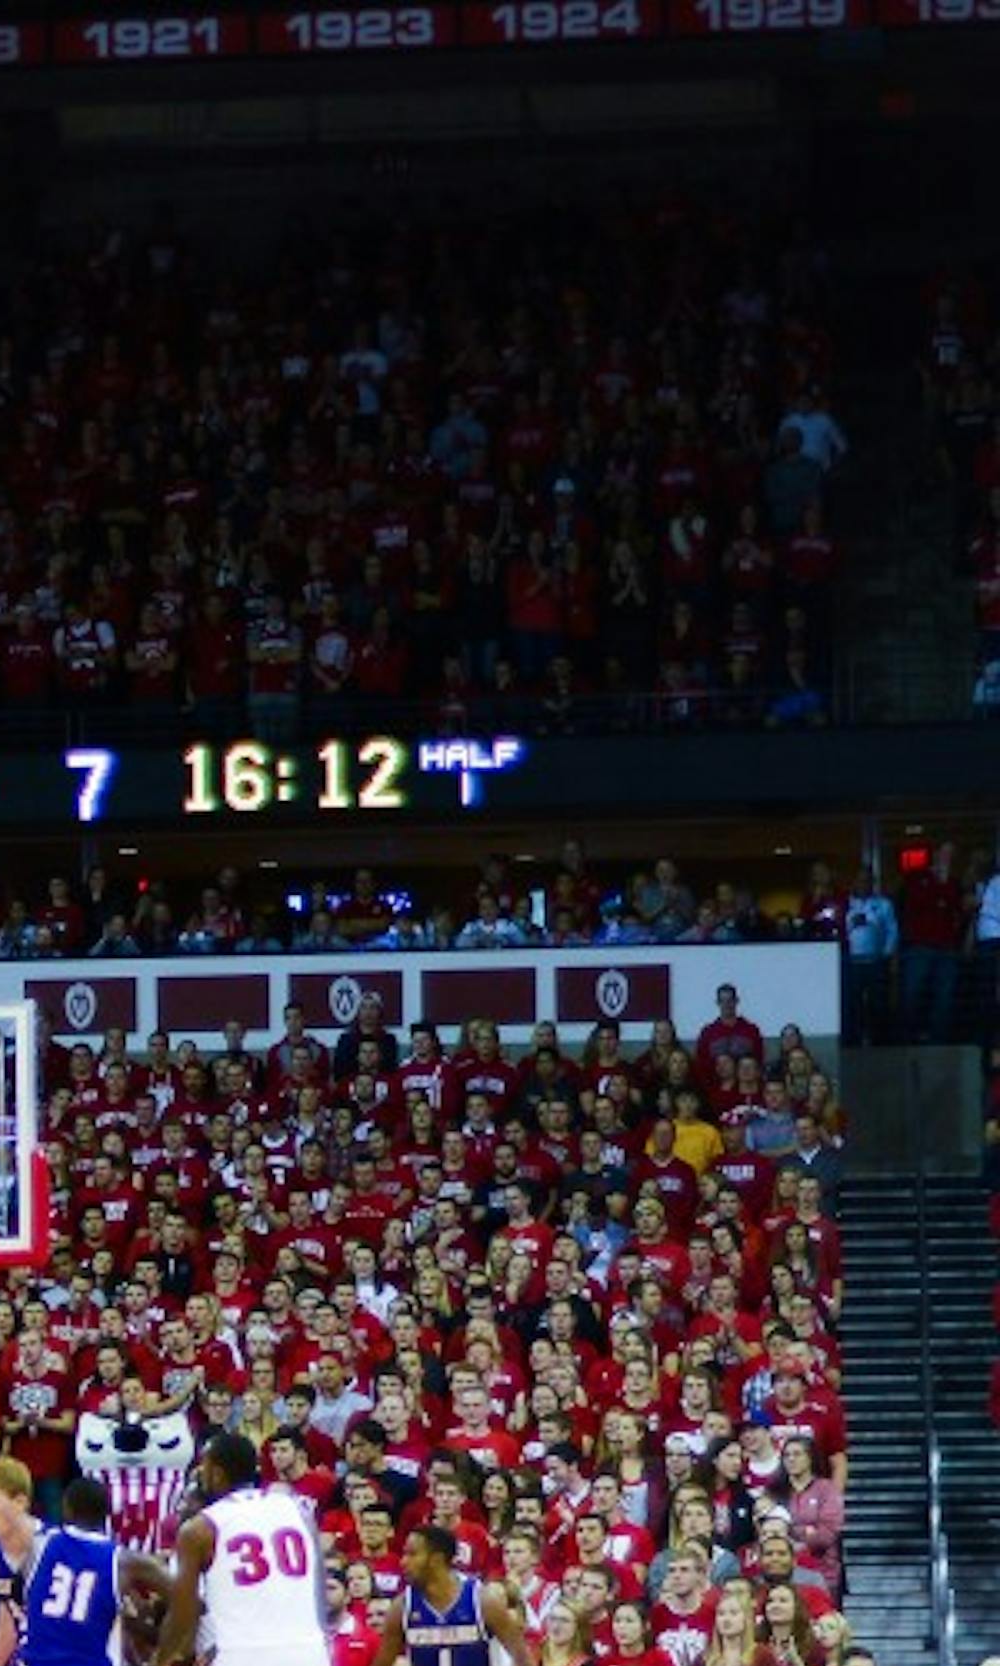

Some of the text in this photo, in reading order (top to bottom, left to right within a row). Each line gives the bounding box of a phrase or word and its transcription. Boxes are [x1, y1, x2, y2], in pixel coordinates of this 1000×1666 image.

[83, 15, 221, 60] 1921
[285, 6, 435, 51] 1923
[491, 0, 641, 42] 1924
[696, 0, 846, 31] 1929
[418, 738, 521, 770] HALF
[65, 748, 112, 821] 7
[226, 1526, 307, 1587] 30
[42, 1561, 97, 1622] 31
